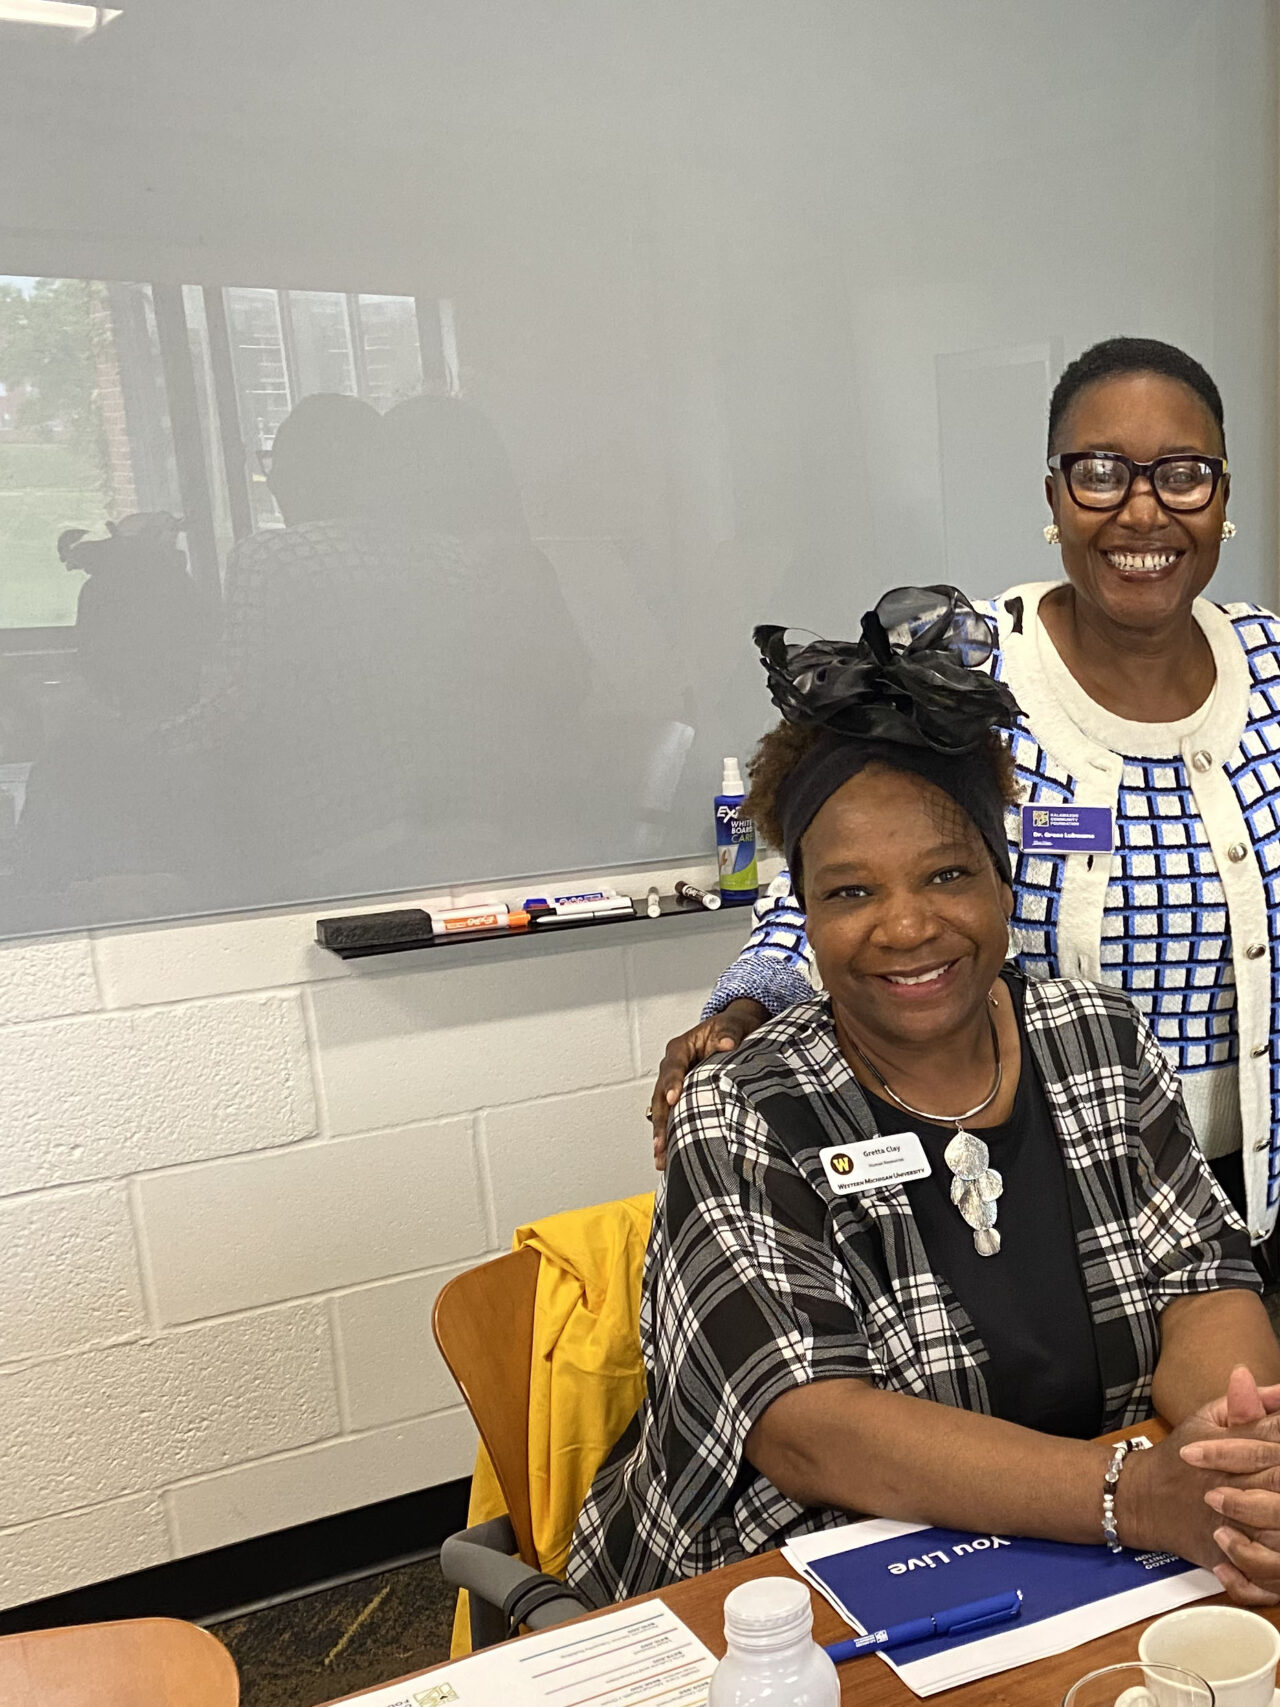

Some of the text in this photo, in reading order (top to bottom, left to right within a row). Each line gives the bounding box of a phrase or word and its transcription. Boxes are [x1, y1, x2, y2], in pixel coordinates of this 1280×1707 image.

[863, 1145, 901, 1157] Gretta Clay
[888, 1535, 1011, 1576] You Live
